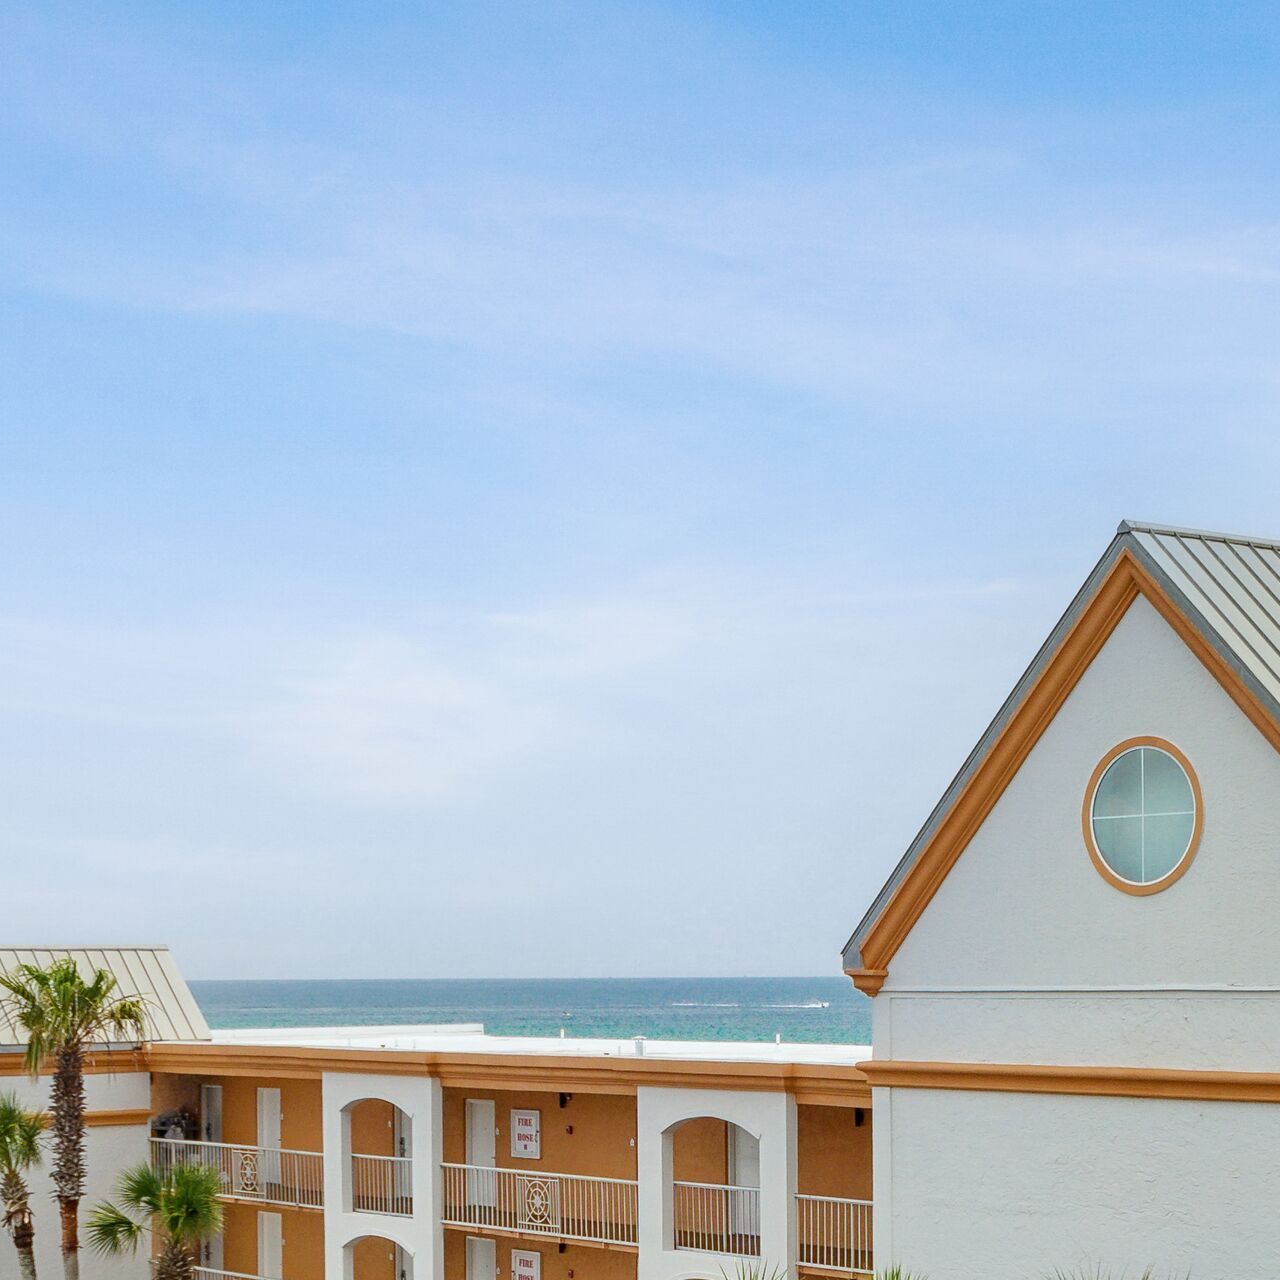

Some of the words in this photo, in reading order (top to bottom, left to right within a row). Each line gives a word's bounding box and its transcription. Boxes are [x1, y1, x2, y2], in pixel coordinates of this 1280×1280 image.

[518, 1117, 533, 1127] FIRE
[517, 1132, 534, 1143] HOSE
[519, 1258, 534, 1269] FIRE
